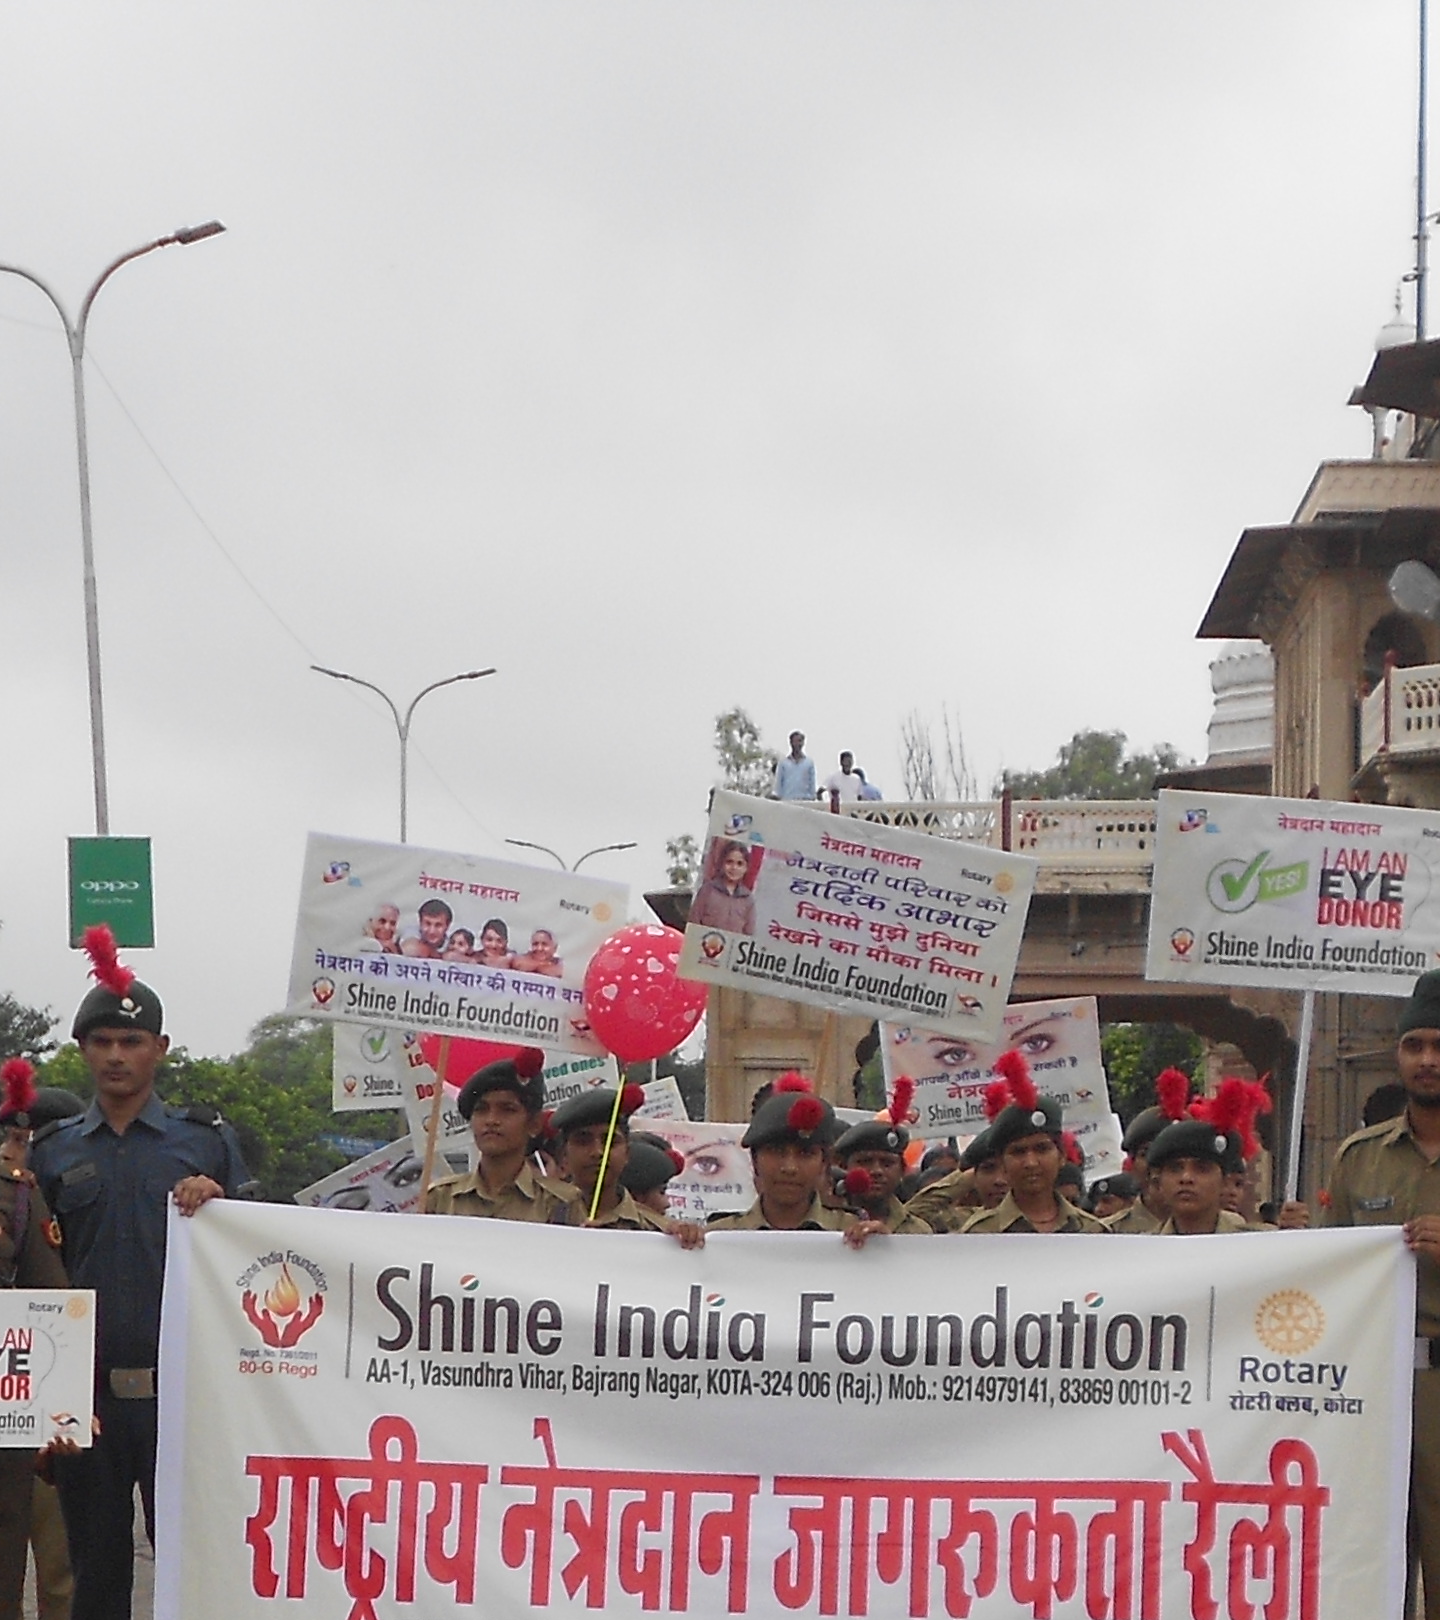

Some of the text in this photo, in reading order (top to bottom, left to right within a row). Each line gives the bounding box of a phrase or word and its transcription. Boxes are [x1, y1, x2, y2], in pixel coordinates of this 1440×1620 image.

[870, 847, 922, 870] महादान
[1335, 849, 1370, 871] AM
[1376, 852, 1407, 875] AN
[1318, 868, 1405, 902] EYE
[895, 900, 997, 938] आभार
[975, 896, 1008, 914] को
[1317, 897, 1402, 929] DONOR
[796, 901, 862, 931] जिससे
[916, 930, 980, 957] दुनिया
[768, 919, 823, 947] देखने
[829, 938, 859, 956] का
[929, 957, 983, 984] मिला
[1206, 931, 1259, 958] Shine
[1266, 935, 1312, 962] India
[1321, 938, 1426, 968] Foundation
[369, 956, 389, 978] को
[486, 972, 506, 993] की
[736, 941, 787, 974] Shine
[793, 953, 840, 985] India
[845, 966, 948, 1009] Foundation
[347, 983, 397, 1012] Shine
[404, 990, 450, 1018] India
[457, 998, 559, 1034] Foundation
[363, 1075, 394, 1091] Shine
[544, 1062, 569, 1079] ved
[543, 1083, 582, 1103] ation
[928, 1102, 962, 1121] Shine
[257, 1250, 283, 1268] India
[286, 1250, 328, 1292] Foundation
[29, 1301, 63, 1314] Rotary
[375, 1262, 1188, 1372] Shine India Foundation
[4, 1328, 33, 1349] AN
[239, 1360, 317, 1379] 80-G Regd
[366, 1358, 1192, 1407] AA-1, Vasundhra Vihar, Bajrang Nagar, KOTA-324 006 (Raj.) Mob.: 9214979141, 83869 00101-2
[1239, 1357, 1347, 1391] Rotary
[1229, 1390, 1365, 1417] रोटरी क्लब, कोटा
[500, 1416, 760, 1614] नेत्रदान
